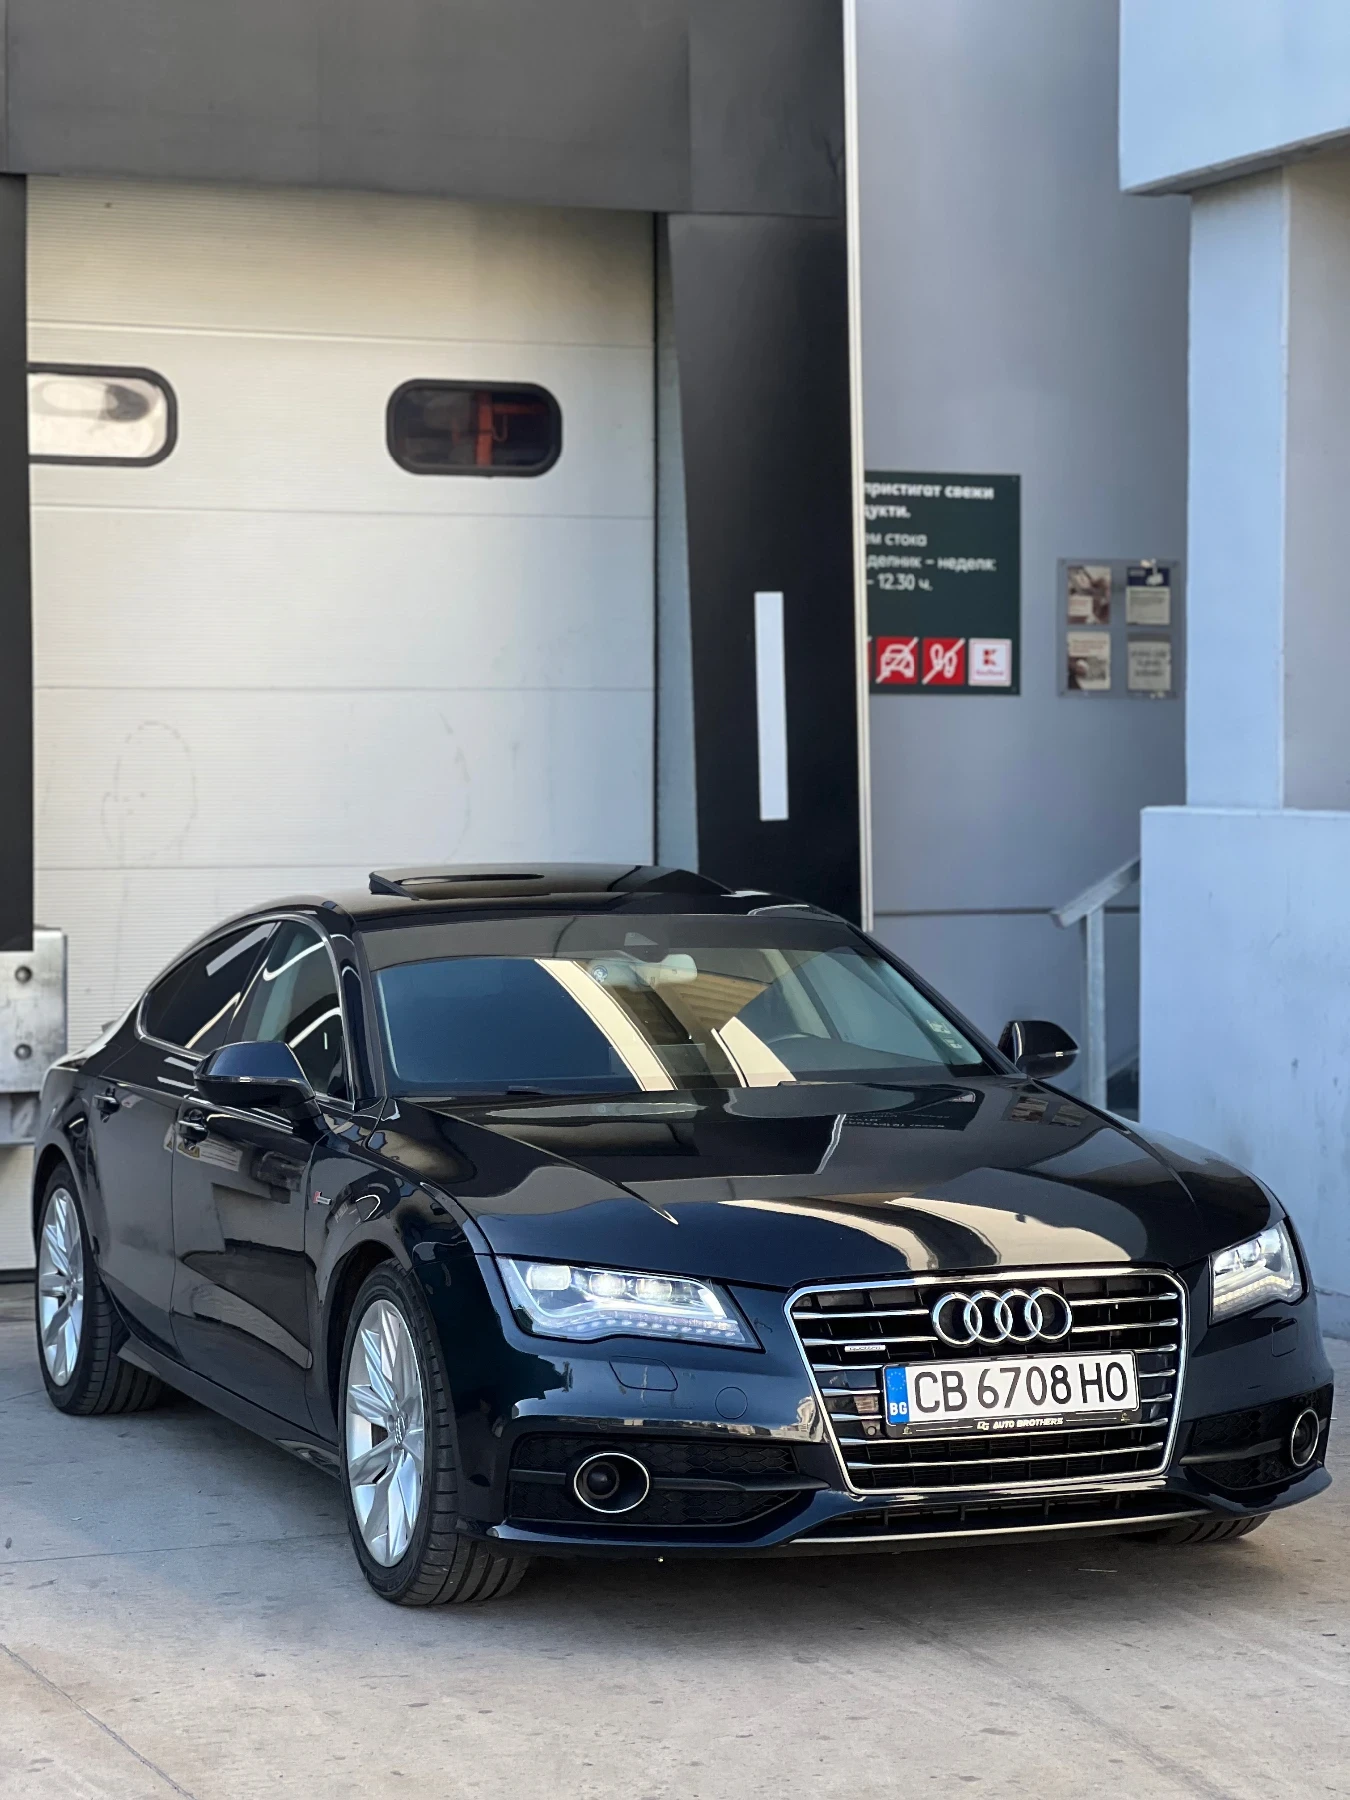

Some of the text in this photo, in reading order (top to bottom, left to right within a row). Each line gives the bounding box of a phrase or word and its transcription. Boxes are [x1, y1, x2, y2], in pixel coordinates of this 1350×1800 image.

[944, 485, 995, 500] свежи
[865, 503, 911, 520] укти.
[884, 533, 928, 547] стока
[877, 572, 916, 591] 12.30
[914, 1361, 1128, 1413] CB 6708 HO
[889, 1401, 908, 1416] BG
[992, 1419, 1015, 1430] AUTO
[1016, 1417, 1064, 1428] BROTHERS
